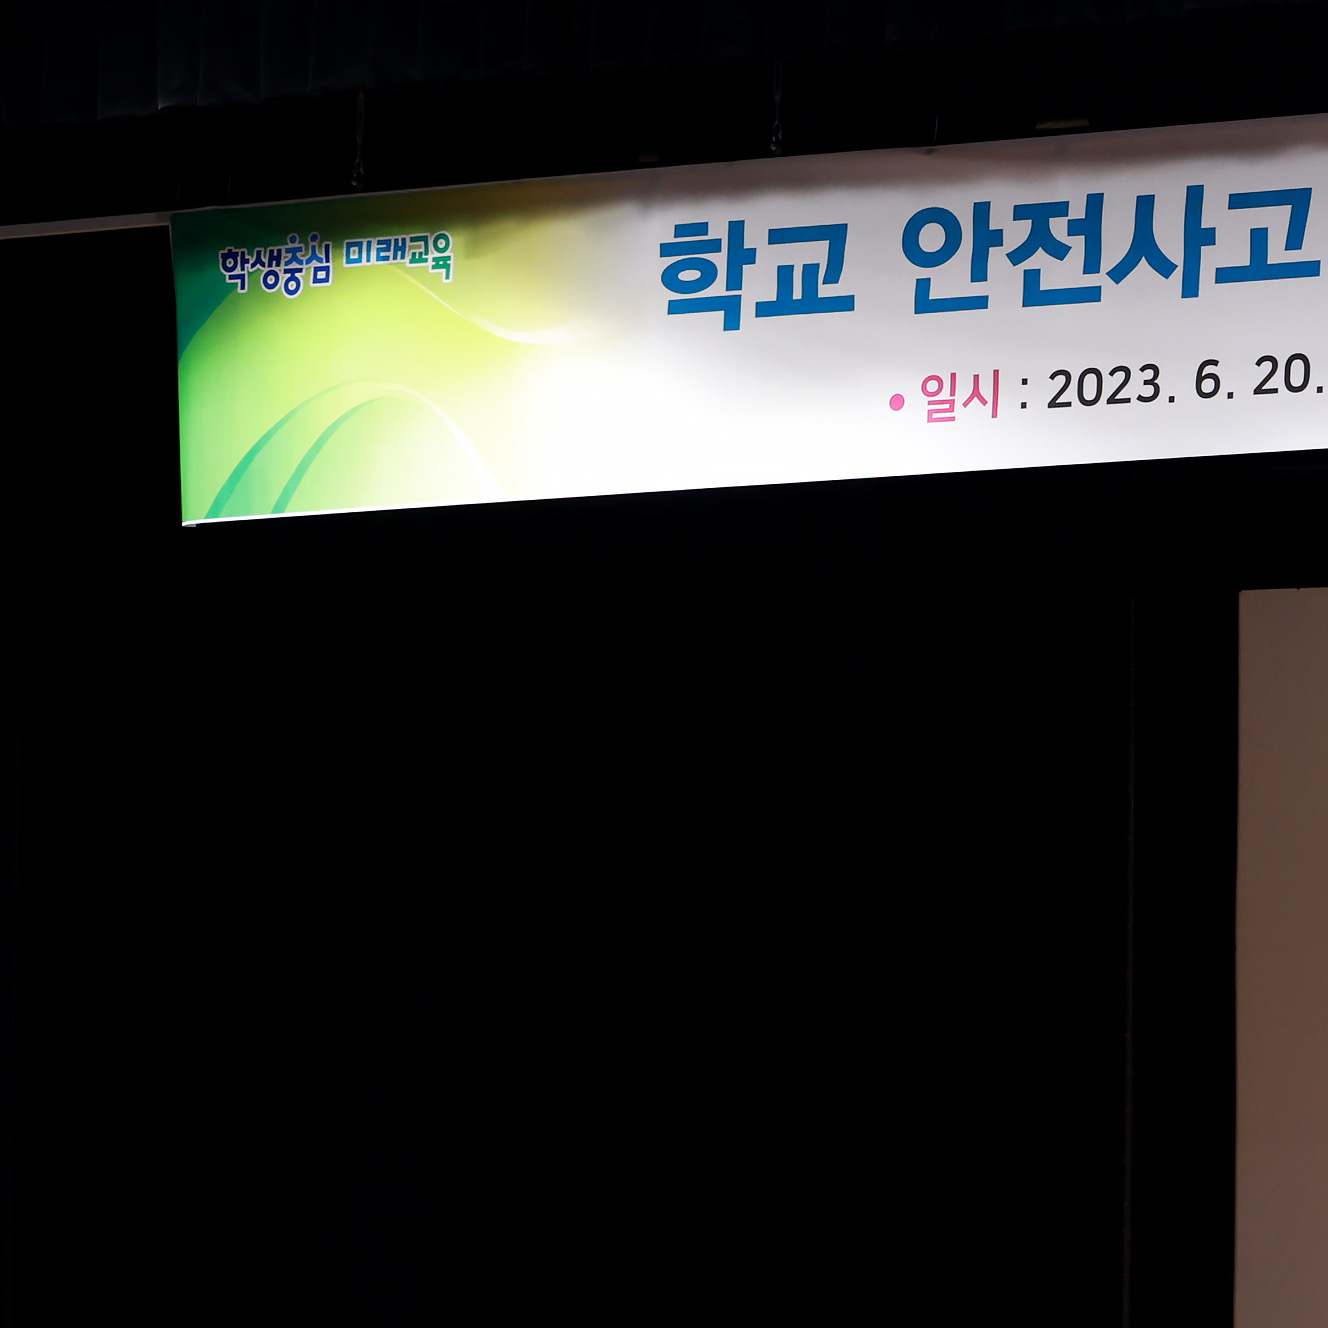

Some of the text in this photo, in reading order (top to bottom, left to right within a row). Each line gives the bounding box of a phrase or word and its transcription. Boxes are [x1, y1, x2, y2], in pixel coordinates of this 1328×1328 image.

[219, 231, 453, 298] 학생중심 미래교육
[659, 219, 856, 332] 학교
[901, 184, 1322, 315] 안전사고
[920, 368, 1001, 424] 일시
[1046, 363, 1176, 409] 2023.
[1195, 358, 1235, 400] 6.
